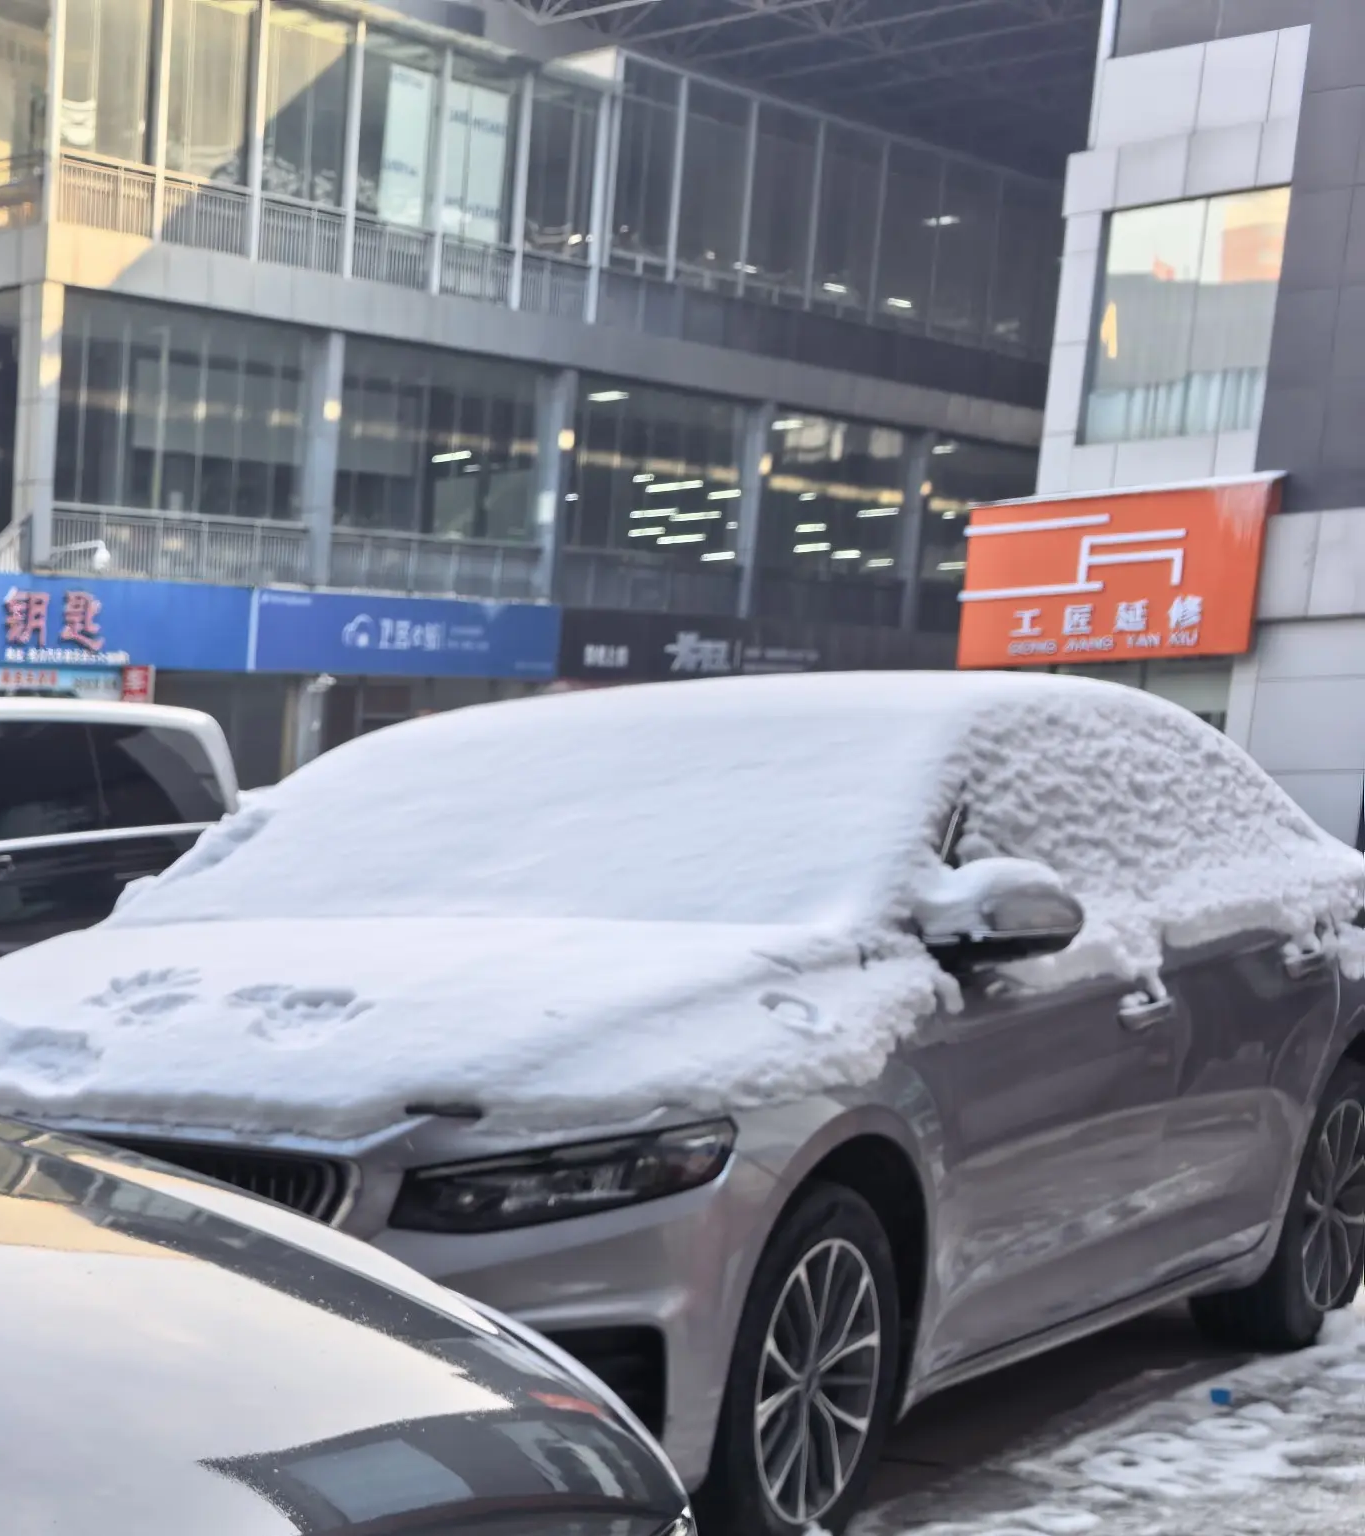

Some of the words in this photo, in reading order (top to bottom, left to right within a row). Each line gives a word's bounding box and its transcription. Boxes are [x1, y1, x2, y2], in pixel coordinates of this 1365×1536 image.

[1009, 594, 1204, 638] 工匠延修
[1126, 632, 1162, 649] YAN
